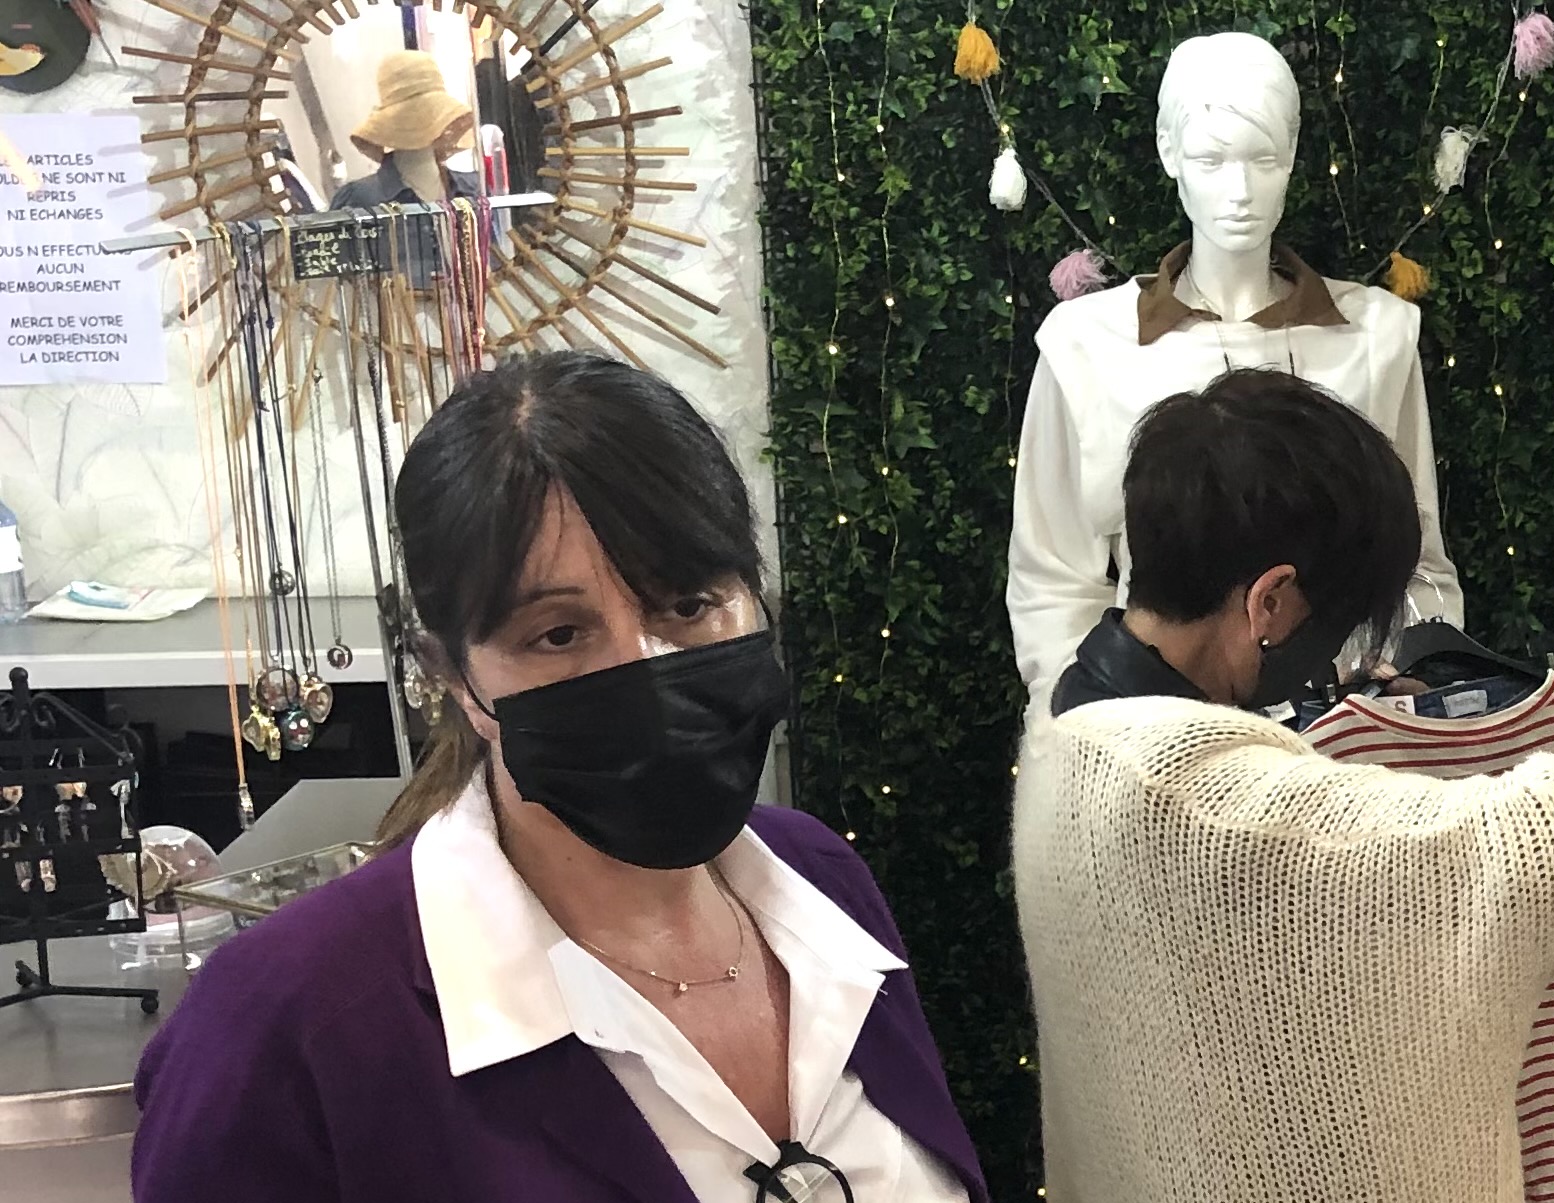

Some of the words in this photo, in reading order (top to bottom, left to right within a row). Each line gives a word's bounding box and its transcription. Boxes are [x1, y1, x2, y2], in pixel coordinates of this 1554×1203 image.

[27, 154, 94, 166] ARTICLES
[42, 172, 60, 184] NE
[65, 172, 105, 184] SONT
[108, 172, 127, 183] NI
[27, 190, 76, 202] REPRIS
[7, 209, 26, 221] NI
[29, 208, 104, 221] ECHANGES
[37, 263, 84, 275] AUCUN
[0, 280, 121, 293] REMBOURSEMENT
[10, 316, 54, 328] MERCI
[58, 316, 76, 328] DE
[79, 315, 124, 328] VOTRE
[7, 333, 128, 346] COMPREHENSION
[20, 352, 37, 364] LA
[41, 351, 119, 363] DIRECTION
